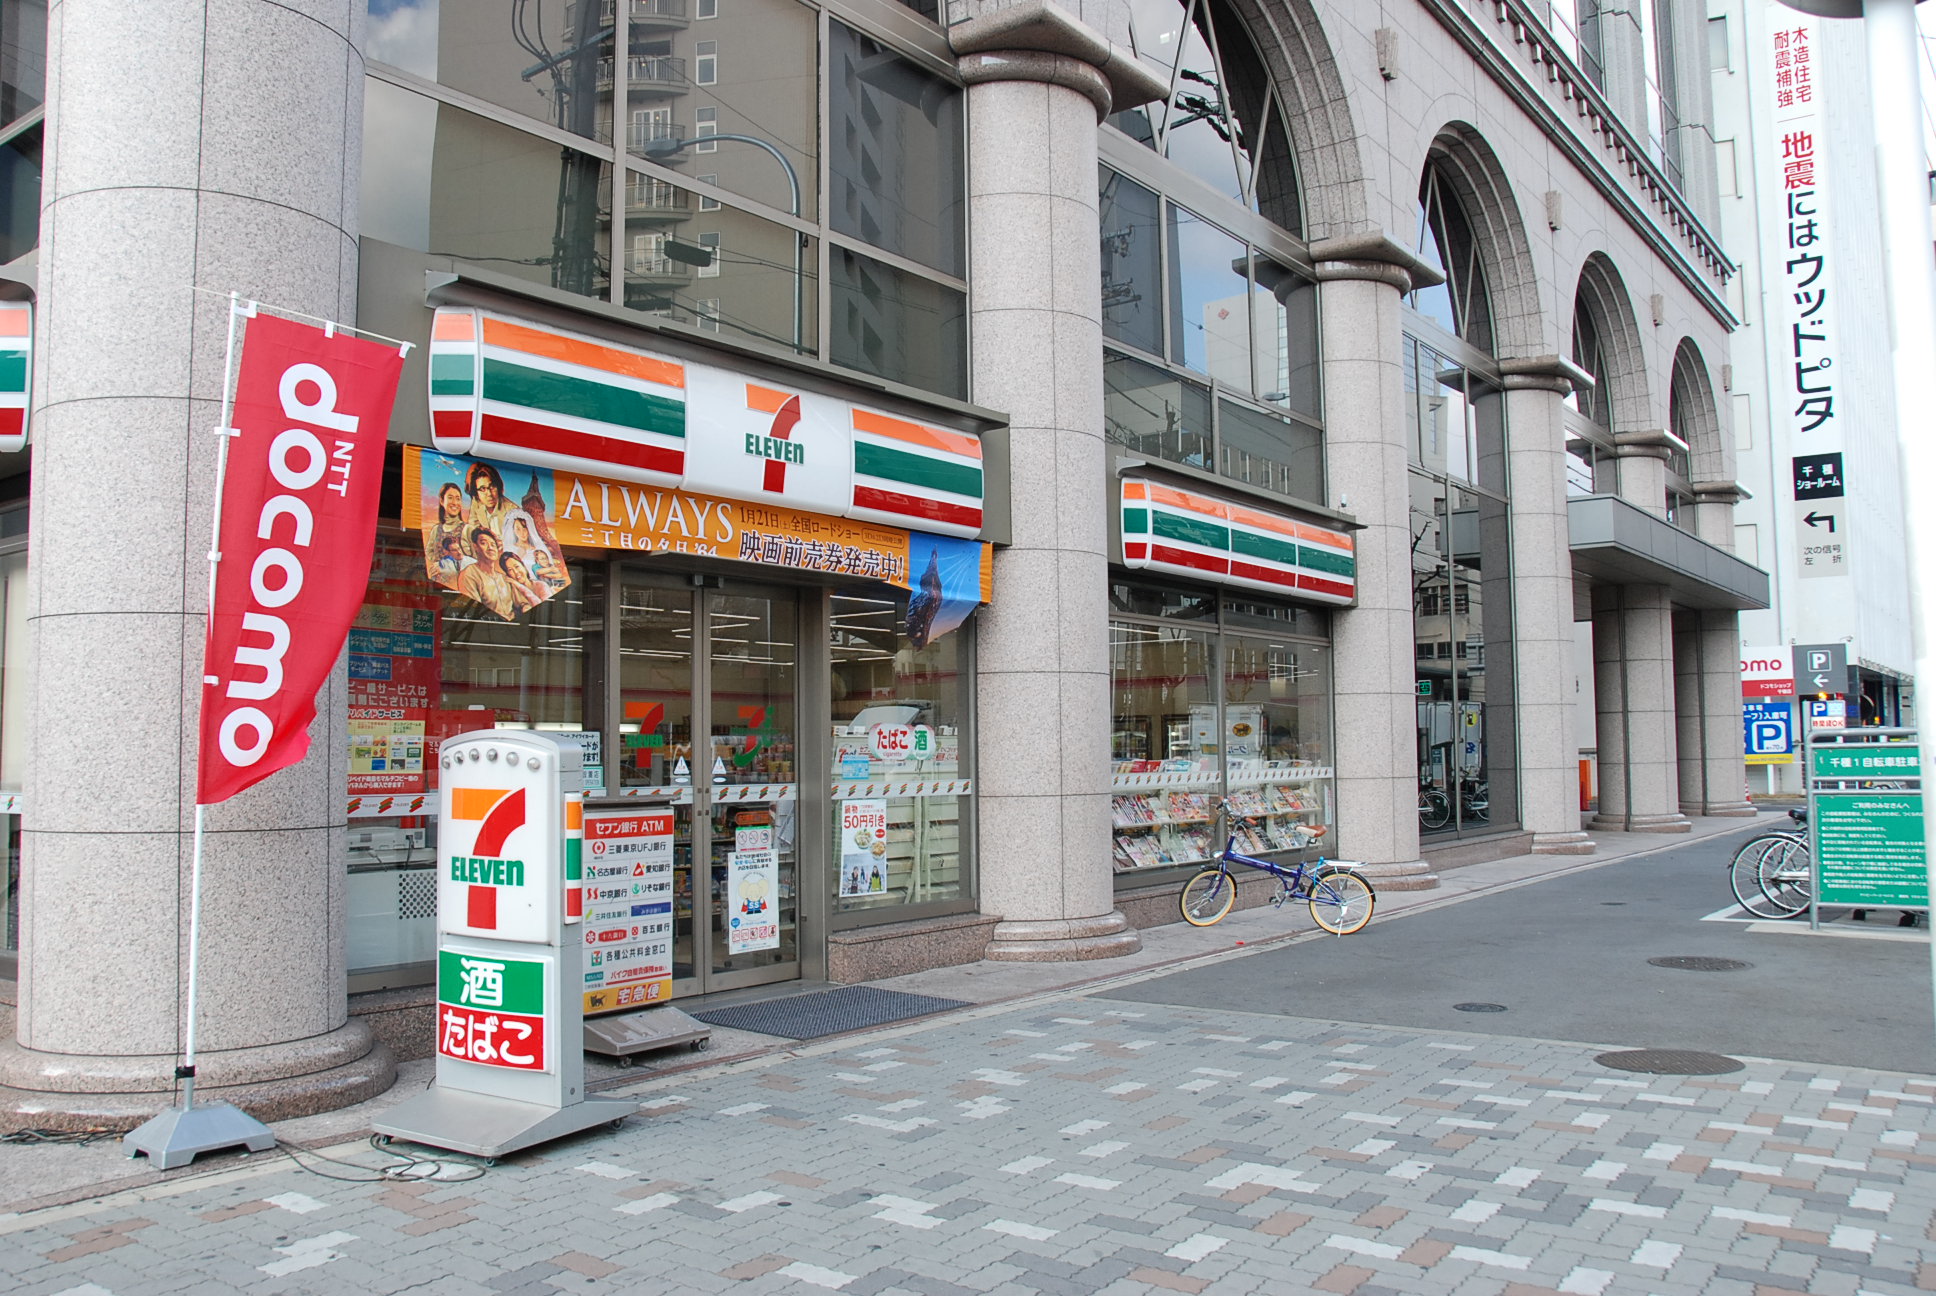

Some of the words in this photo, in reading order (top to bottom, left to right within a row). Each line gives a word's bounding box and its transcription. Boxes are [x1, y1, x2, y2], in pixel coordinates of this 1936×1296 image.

[1773, 29, 1794, 108] 耐震補強
[1792, 26, 1812, 103] 木造住宅
[1781, 130, 1834, 432] 地震にはウッドピタ
[327, 441, 355, 496] NTT
[1796, 476, 1841, 490] ショールーム
[560, 477, 734, 543] ALWAYS
[580, 527, 688, 553] 三丁目の夕日
[1803, 544, 1841, 555] 次の信号
[219, 363, 359, 767] docomo
[739, 530, 904, 583] 映画前売券発売中!
[877, 728, 909, 750] たばこ
[914, 730, 928, 751] 酒
[596, 821, 638, 835] セブン銀行
[641, 820, 664, 833] ATM
[844, 814, 885, 829] 50円引き
[608, 841, 667, 855] 三菱東京UFJ銀行
[597, 866, 628, 877] 名古屋銀行
[646, 863, 671, 873] 愛知銀行
[599, 888, 628, 899] 中京銀行
[641, 882, 671, 893] りそな銀行
[595, 910, 628, 920] 三井住友銀行
[749, 901, 759, 909] SS
[642, 922, 670, 934] 百五銀行
[606, 943, 666, 962] 各種公共料金窓口
[460, 957, 505, 1006] 酒
[617, 982, 661, 1005] 宅急便
[443, 1009, 535, 1065] たばこ
